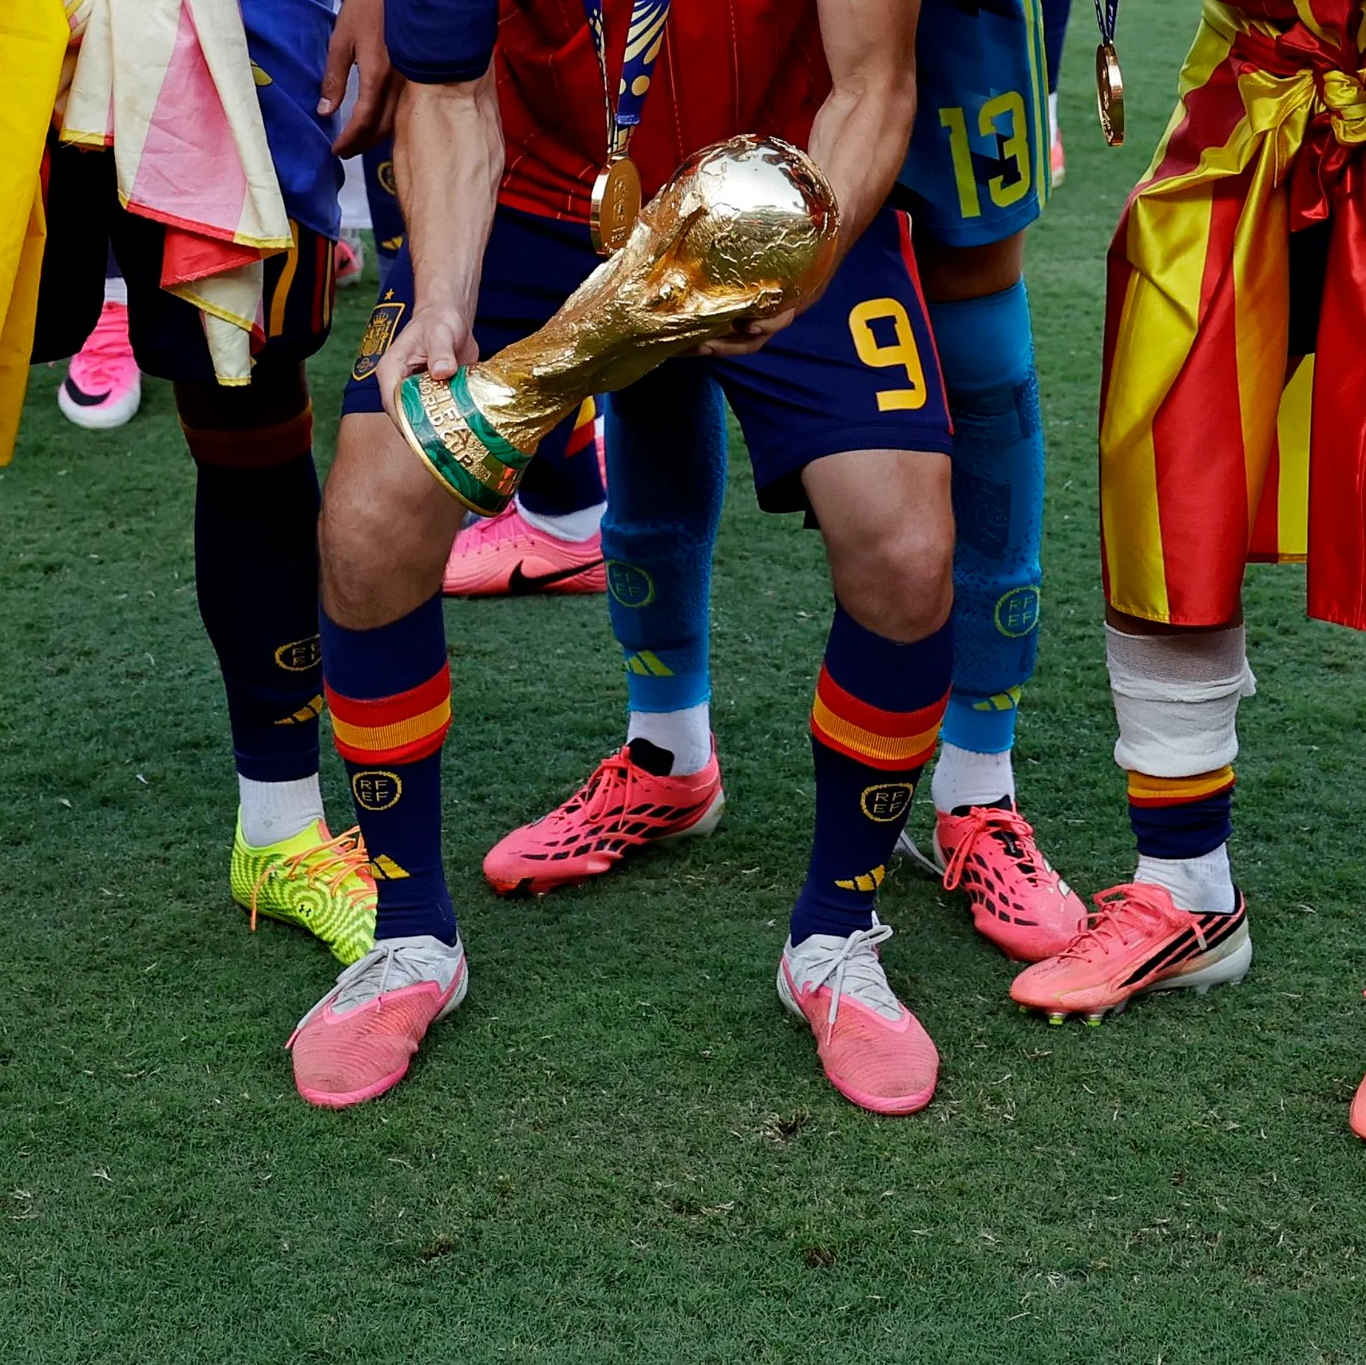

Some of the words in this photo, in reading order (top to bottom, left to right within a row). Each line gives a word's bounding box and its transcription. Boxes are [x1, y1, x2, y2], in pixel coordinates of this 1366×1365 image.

[939, 92, 1031, 219] 13
[849, 298, 927, 412] 9
[1009, 595, 1035, 611] RF
[1008, 611, 1033, 628] EF
[360, 779, 389, 791] RF
[361, 791, 389, 803] EF
[875, 790, 907, 802] RF
[873, 802, 902, 814] EF
